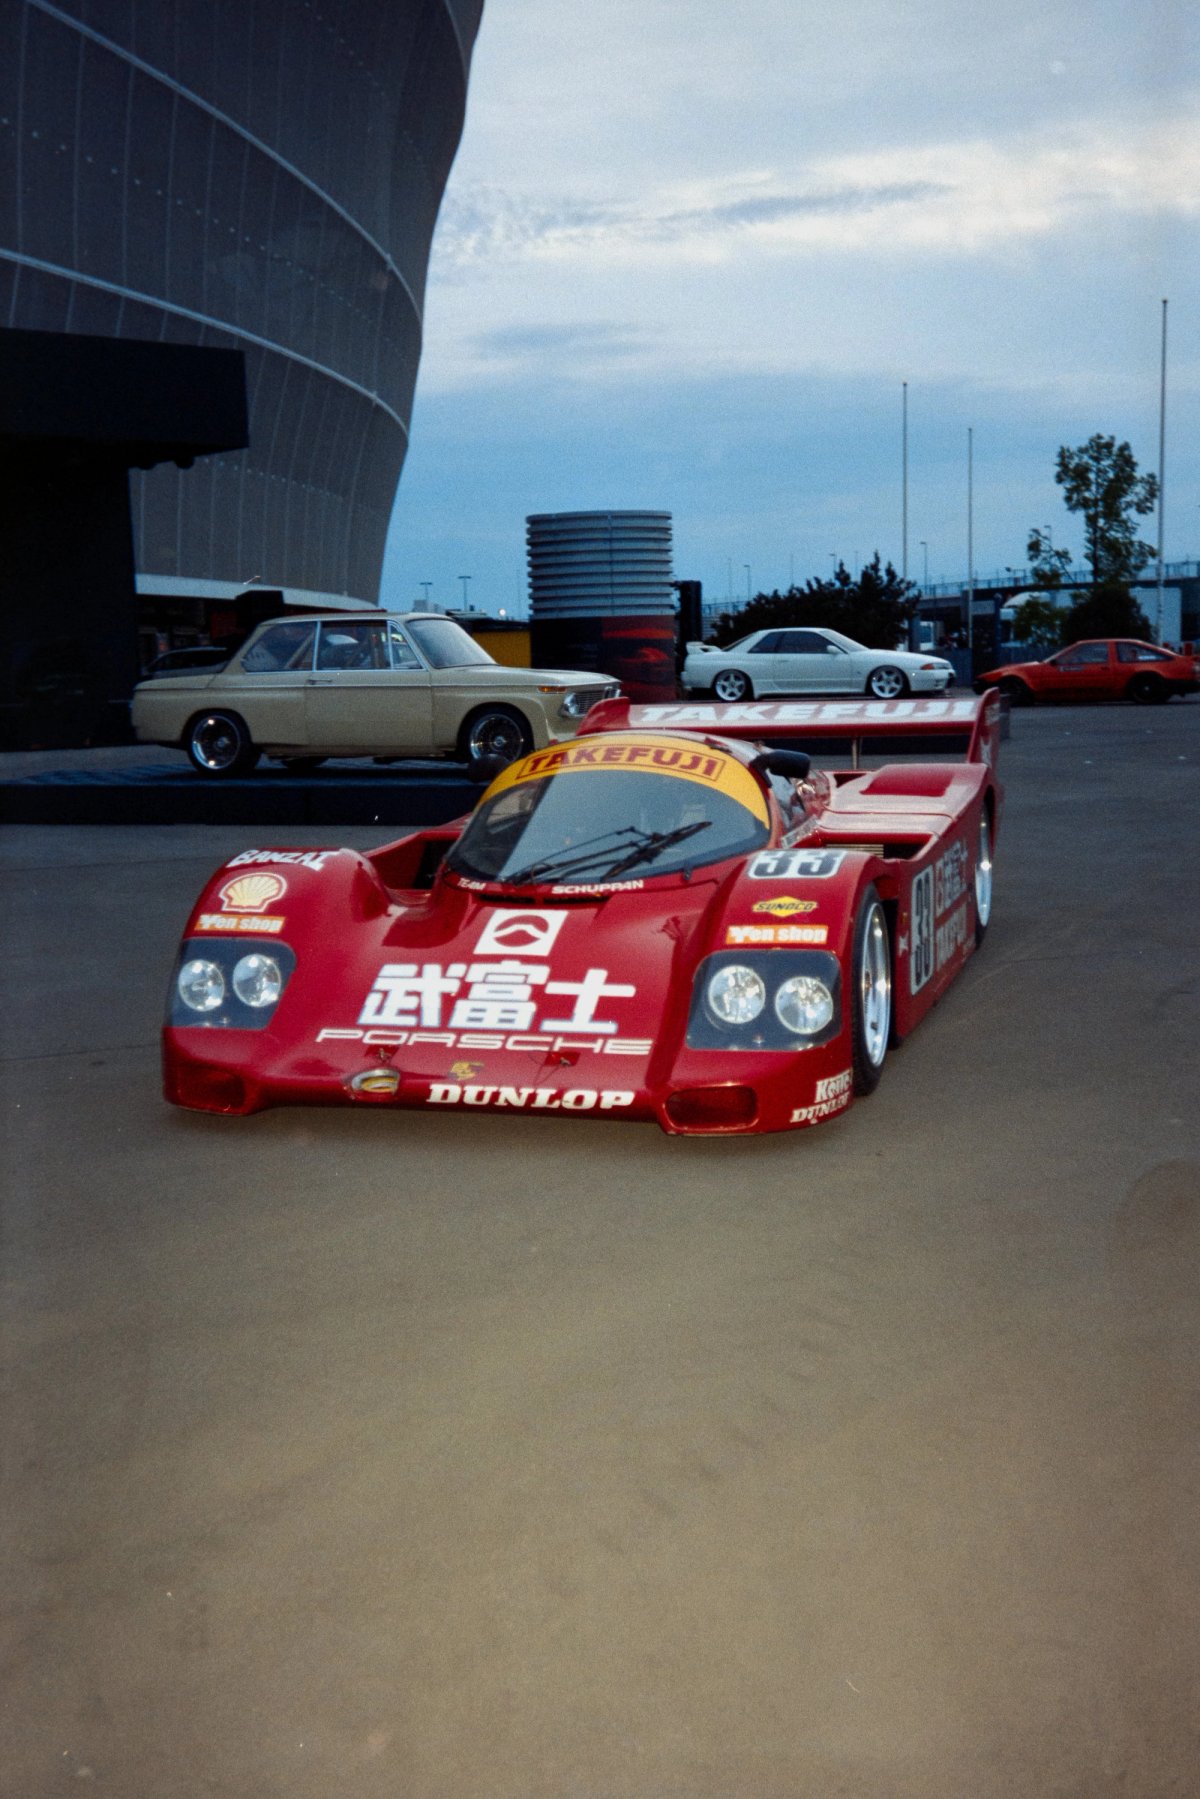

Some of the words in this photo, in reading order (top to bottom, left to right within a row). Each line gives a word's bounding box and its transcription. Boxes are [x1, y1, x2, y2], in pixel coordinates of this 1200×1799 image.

[640, 703, 978, 723] TAKEFUJI
[528, 746, 717, 778] TAKEFUJI
[225, 850, 327, 872] BANZAI
[457, 877, 486, 891] TEAM
[552, 879, 645, 895] SCHUPPAN
[756, 902, 815, 912] SUNOCO
[201, 914, 238, 930] Yen
[241, 916, 283, 933] shop
[729, 926, 774, 943] Yen
[777, 925, 827, 943] shop
[357, 960, 637, 1034] 武富士
[315, 1027, 653, 1055] PORSCHE
[426, 1083, 636, 1109] DUNLOP
